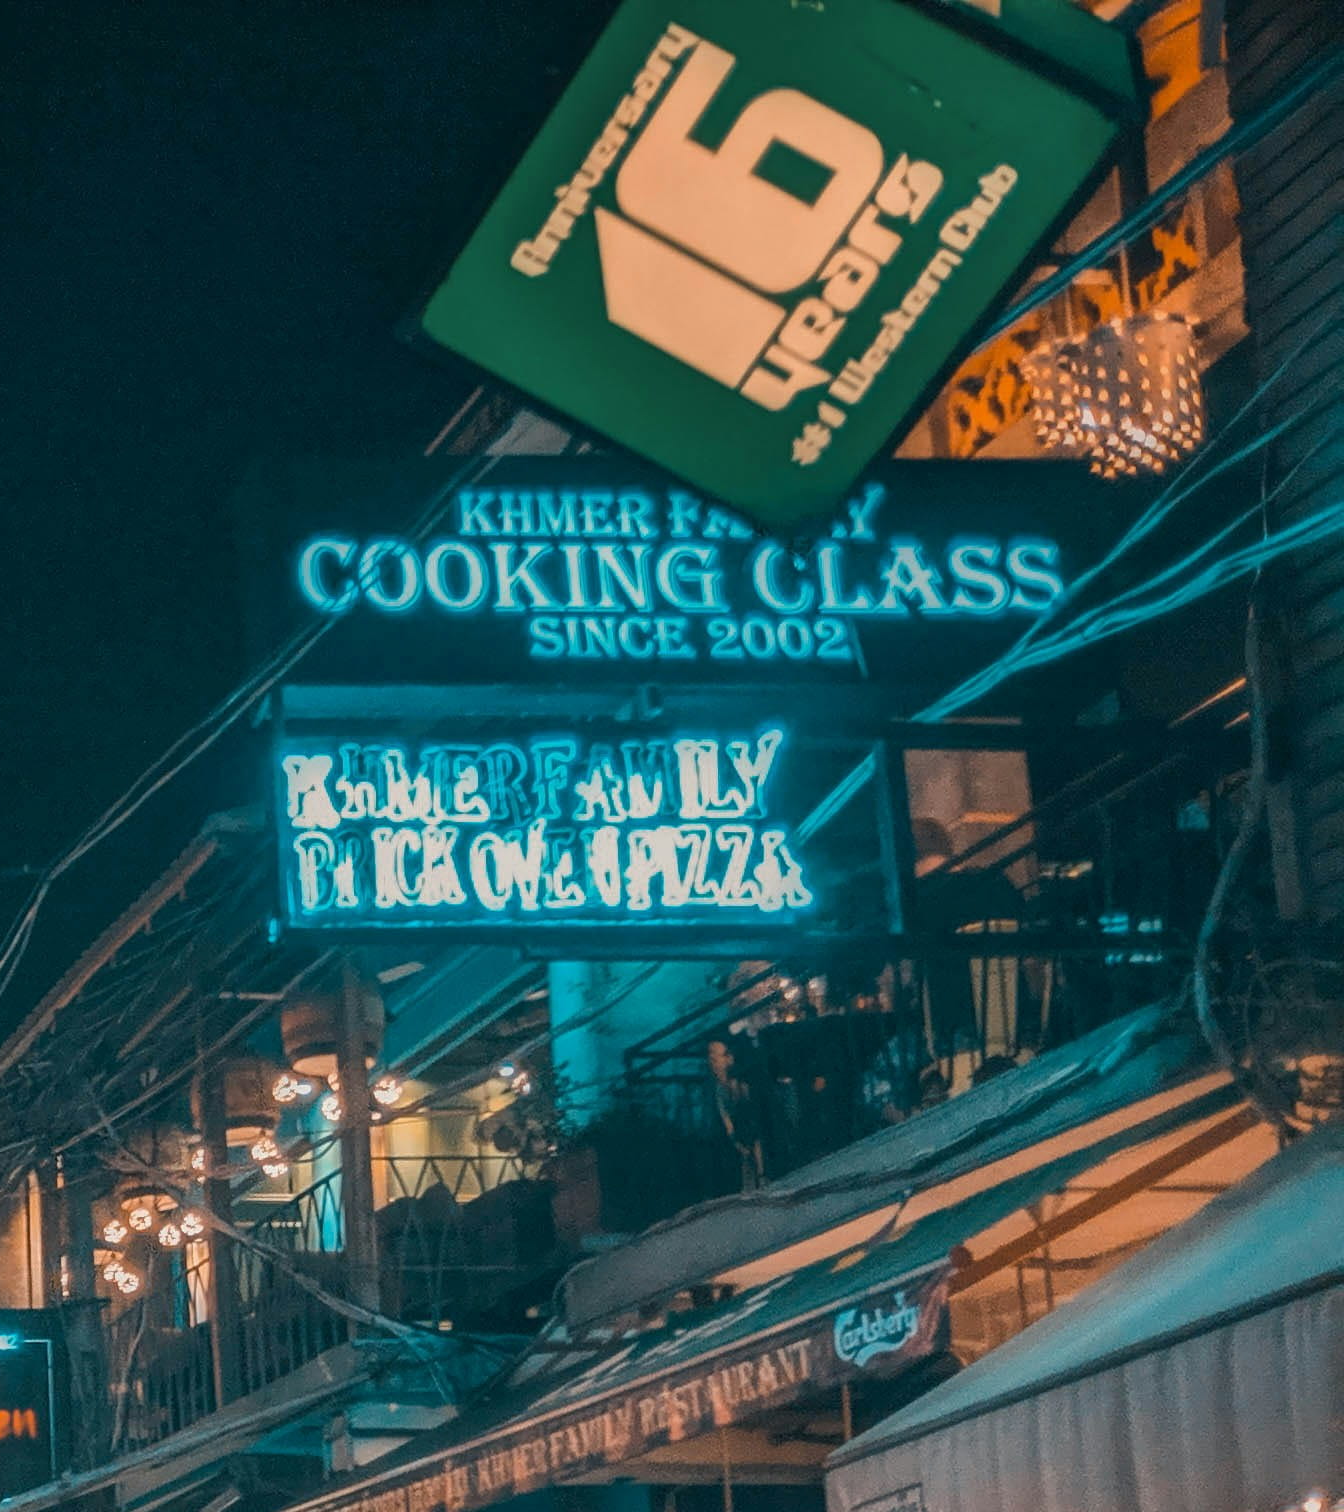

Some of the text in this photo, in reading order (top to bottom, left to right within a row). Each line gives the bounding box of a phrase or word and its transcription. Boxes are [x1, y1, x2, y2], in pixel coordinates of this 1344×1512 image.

[510, 20, 702, 278] Anniversary
[594, 38, 886, 391] 16
[791, 163, 1019, 467] #1 Western Club
[458, 490, 657, 538] KHMER
[297, 539, 1062, 616] COOKING CLASS
[528, 615, 854, 661] SINCE 2002
[834, 1291, 921, 1367] Carlsberg
